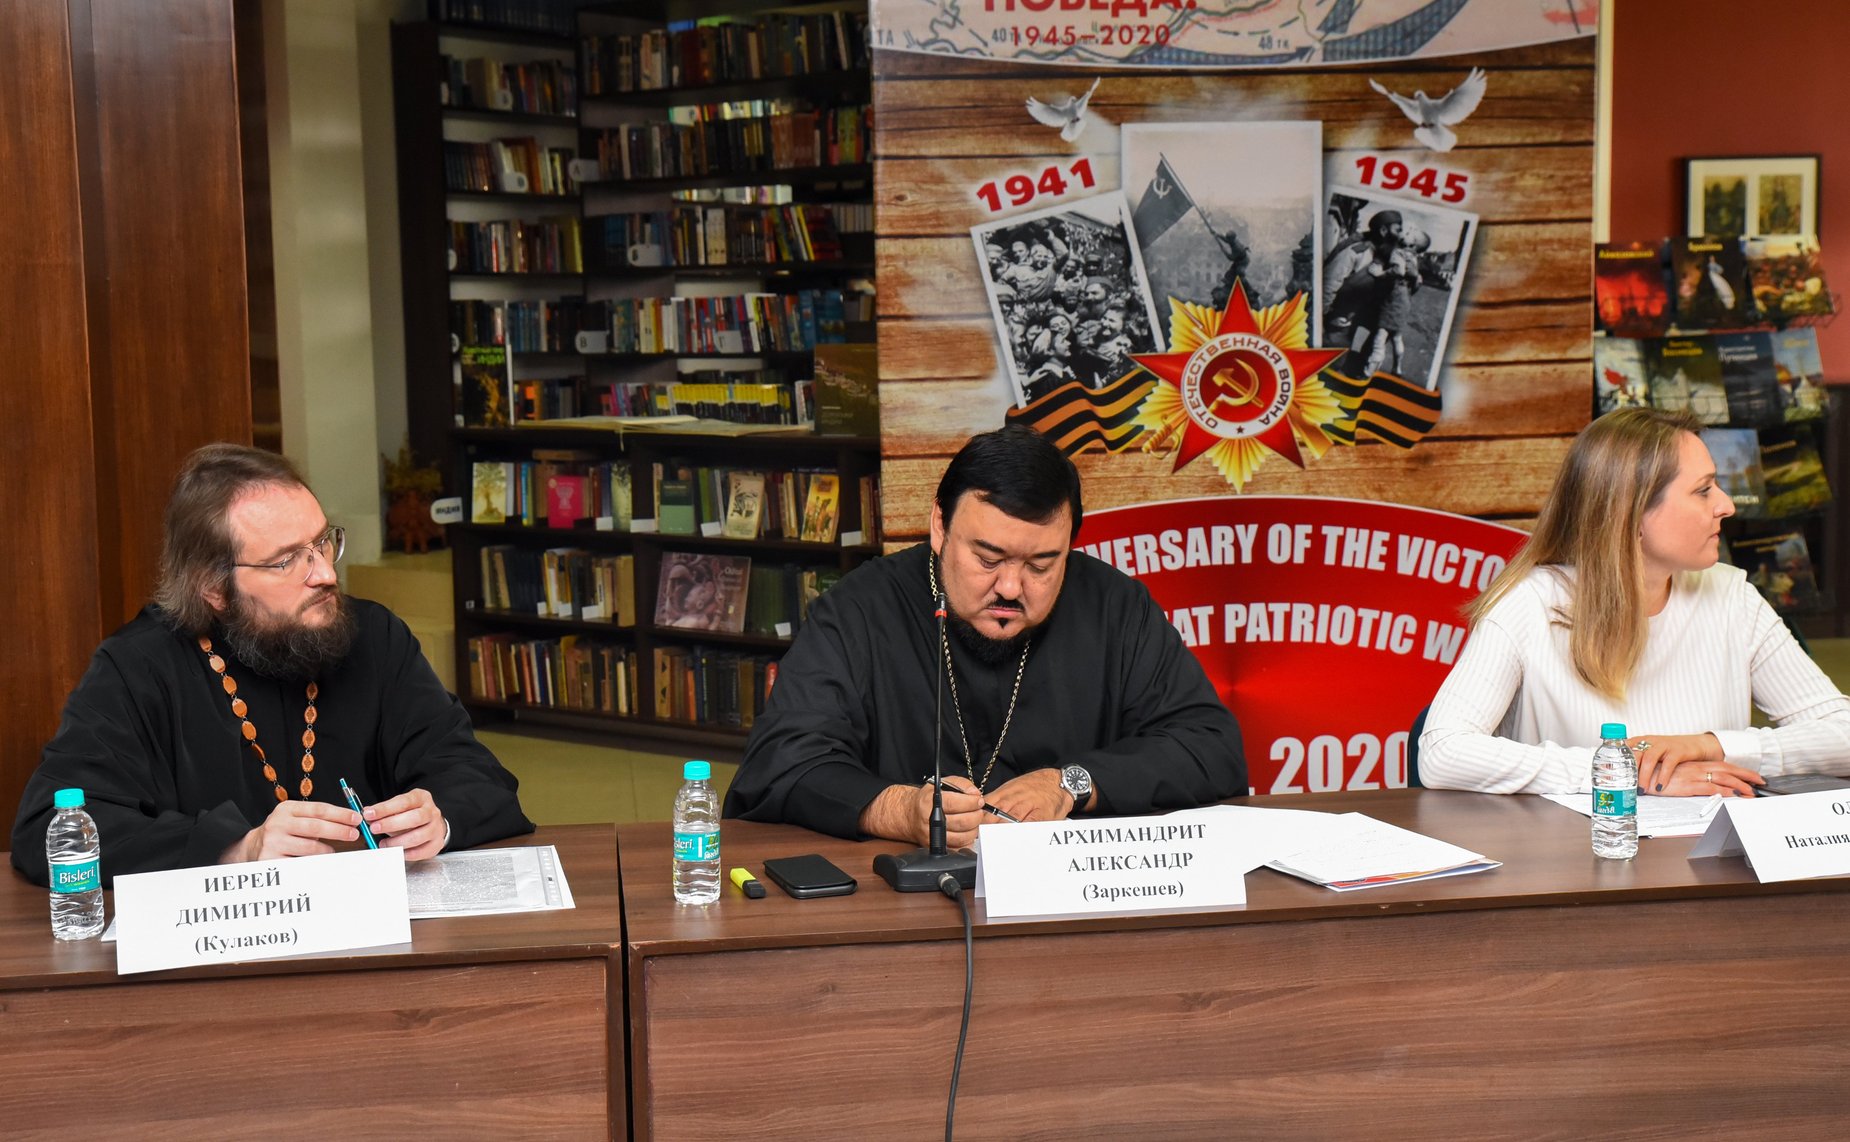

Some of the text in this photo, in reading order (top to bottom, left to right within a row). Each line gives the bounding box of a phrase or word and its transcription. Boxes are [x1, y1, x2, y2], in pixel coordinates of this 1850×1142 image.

[976, 157, 1096, 212] 1941
[1355, 155, 1469, 203] 1945
[1186, 336, 1283, 430] ОТЕЧЕСТВЕННАЯ
[1072, 522, 1506, 594] VERSARY OF THE VICTO
[1164, 602, 1467, 666] AT PATRIOTIC W
[1269, 731, 1409, 795] 2020
[1049, 823, 1207, 847] АРХИМАНДРИТ
[1785, 832, 1850, 849] Наталия
[59, 865, 95, 884] Bisleri
[1068, 851, 1195, 873] АЛЕКСАНДР
[203, 866, 281, 894] ИЕРЕЙ
[1082, 879, 1185, 903] (Заркешев)
[175, 893, 312, 928] ДИМИТРИЙ
[194, 927, 299, 956] (Кулаков)
